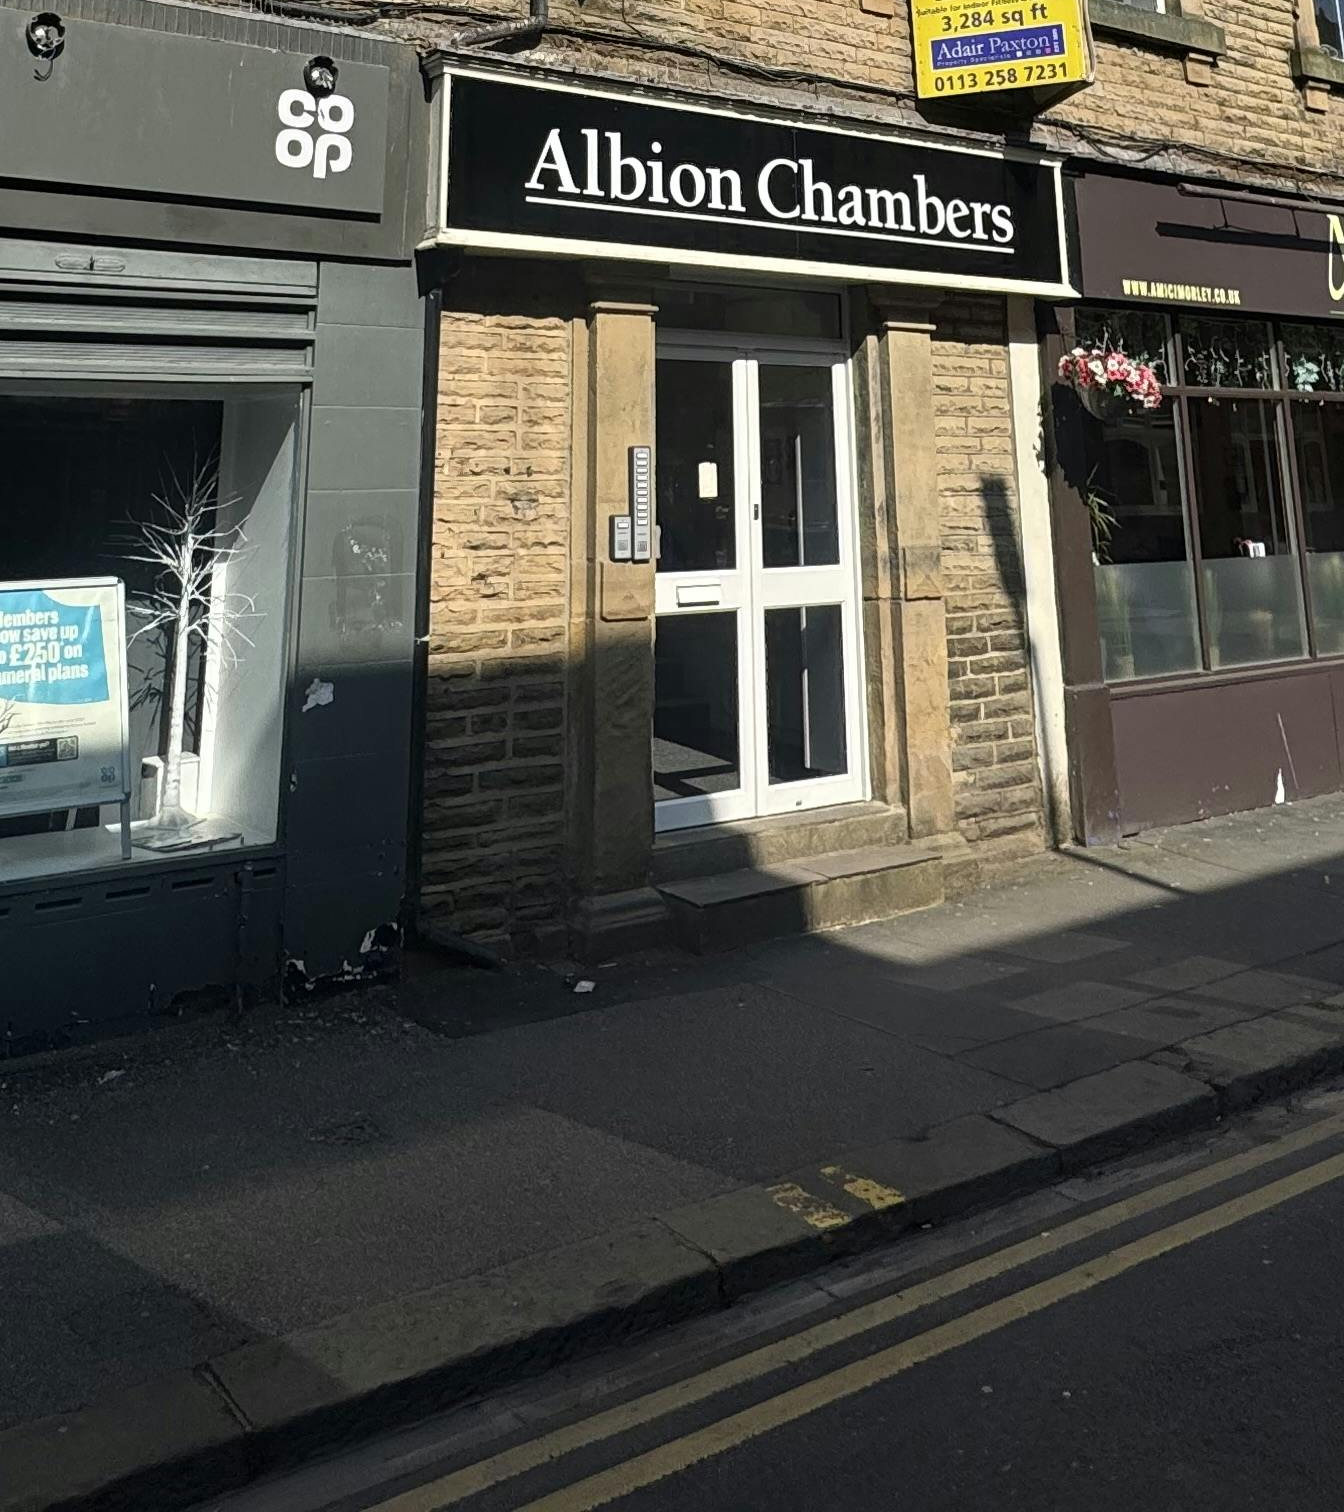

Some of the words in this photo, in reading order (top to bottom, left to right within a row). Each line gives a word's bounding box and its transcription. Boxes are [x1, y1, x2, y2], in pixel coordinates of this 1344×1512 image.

[941, 10, 995, 33] 3,284
[1001, 11, 1024, 28] sq
[1032, 3, 1048, 20] ft
[936, 39, 984, 61] Adair
[988, 35, 1050, 54] Paxton
[934, 73, 977, 91] 0113
[985, 68, 1018, 87] 258
[1023, 62, 1069, 81] 7231
[525, 128, 746, 213] Albion
[758, 157, 1015, 244] Chambers
[1122, 278, 1241, 306] WWW.AMICIMORLEY.CO.UK
[23, 626, 59, 642] save
[60, 624, 79, 642] up
[64, 643, 83, 659] on
[48, 661, 89, 682] plans
